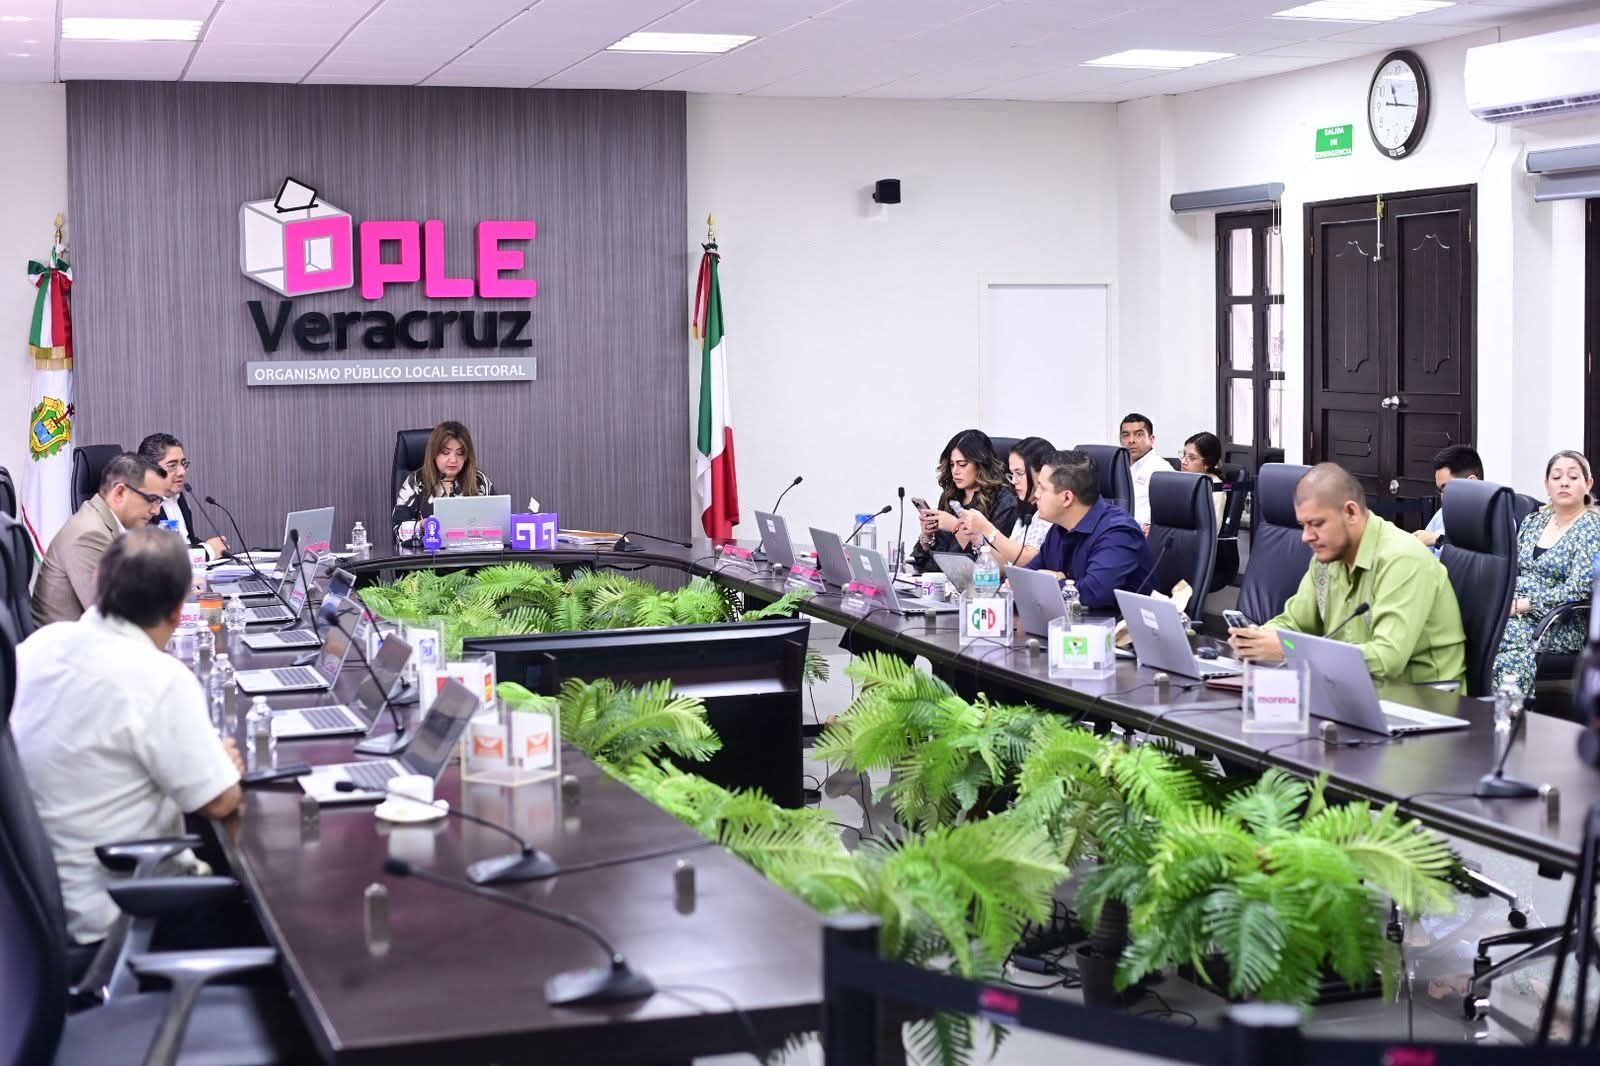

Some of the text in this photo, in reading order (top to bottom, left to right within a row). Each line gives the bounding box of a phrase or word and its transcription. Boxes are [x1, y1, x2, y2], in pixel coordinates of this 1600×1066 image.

[284, 215, 537, 300] OPLE
[248, 300, 533, 353] Veracruz
[254, 365, 526, 381] ORGANISMO PÚBLICO LOCAL ELECTORAL
[1258, 696, 1297, 704] morena
